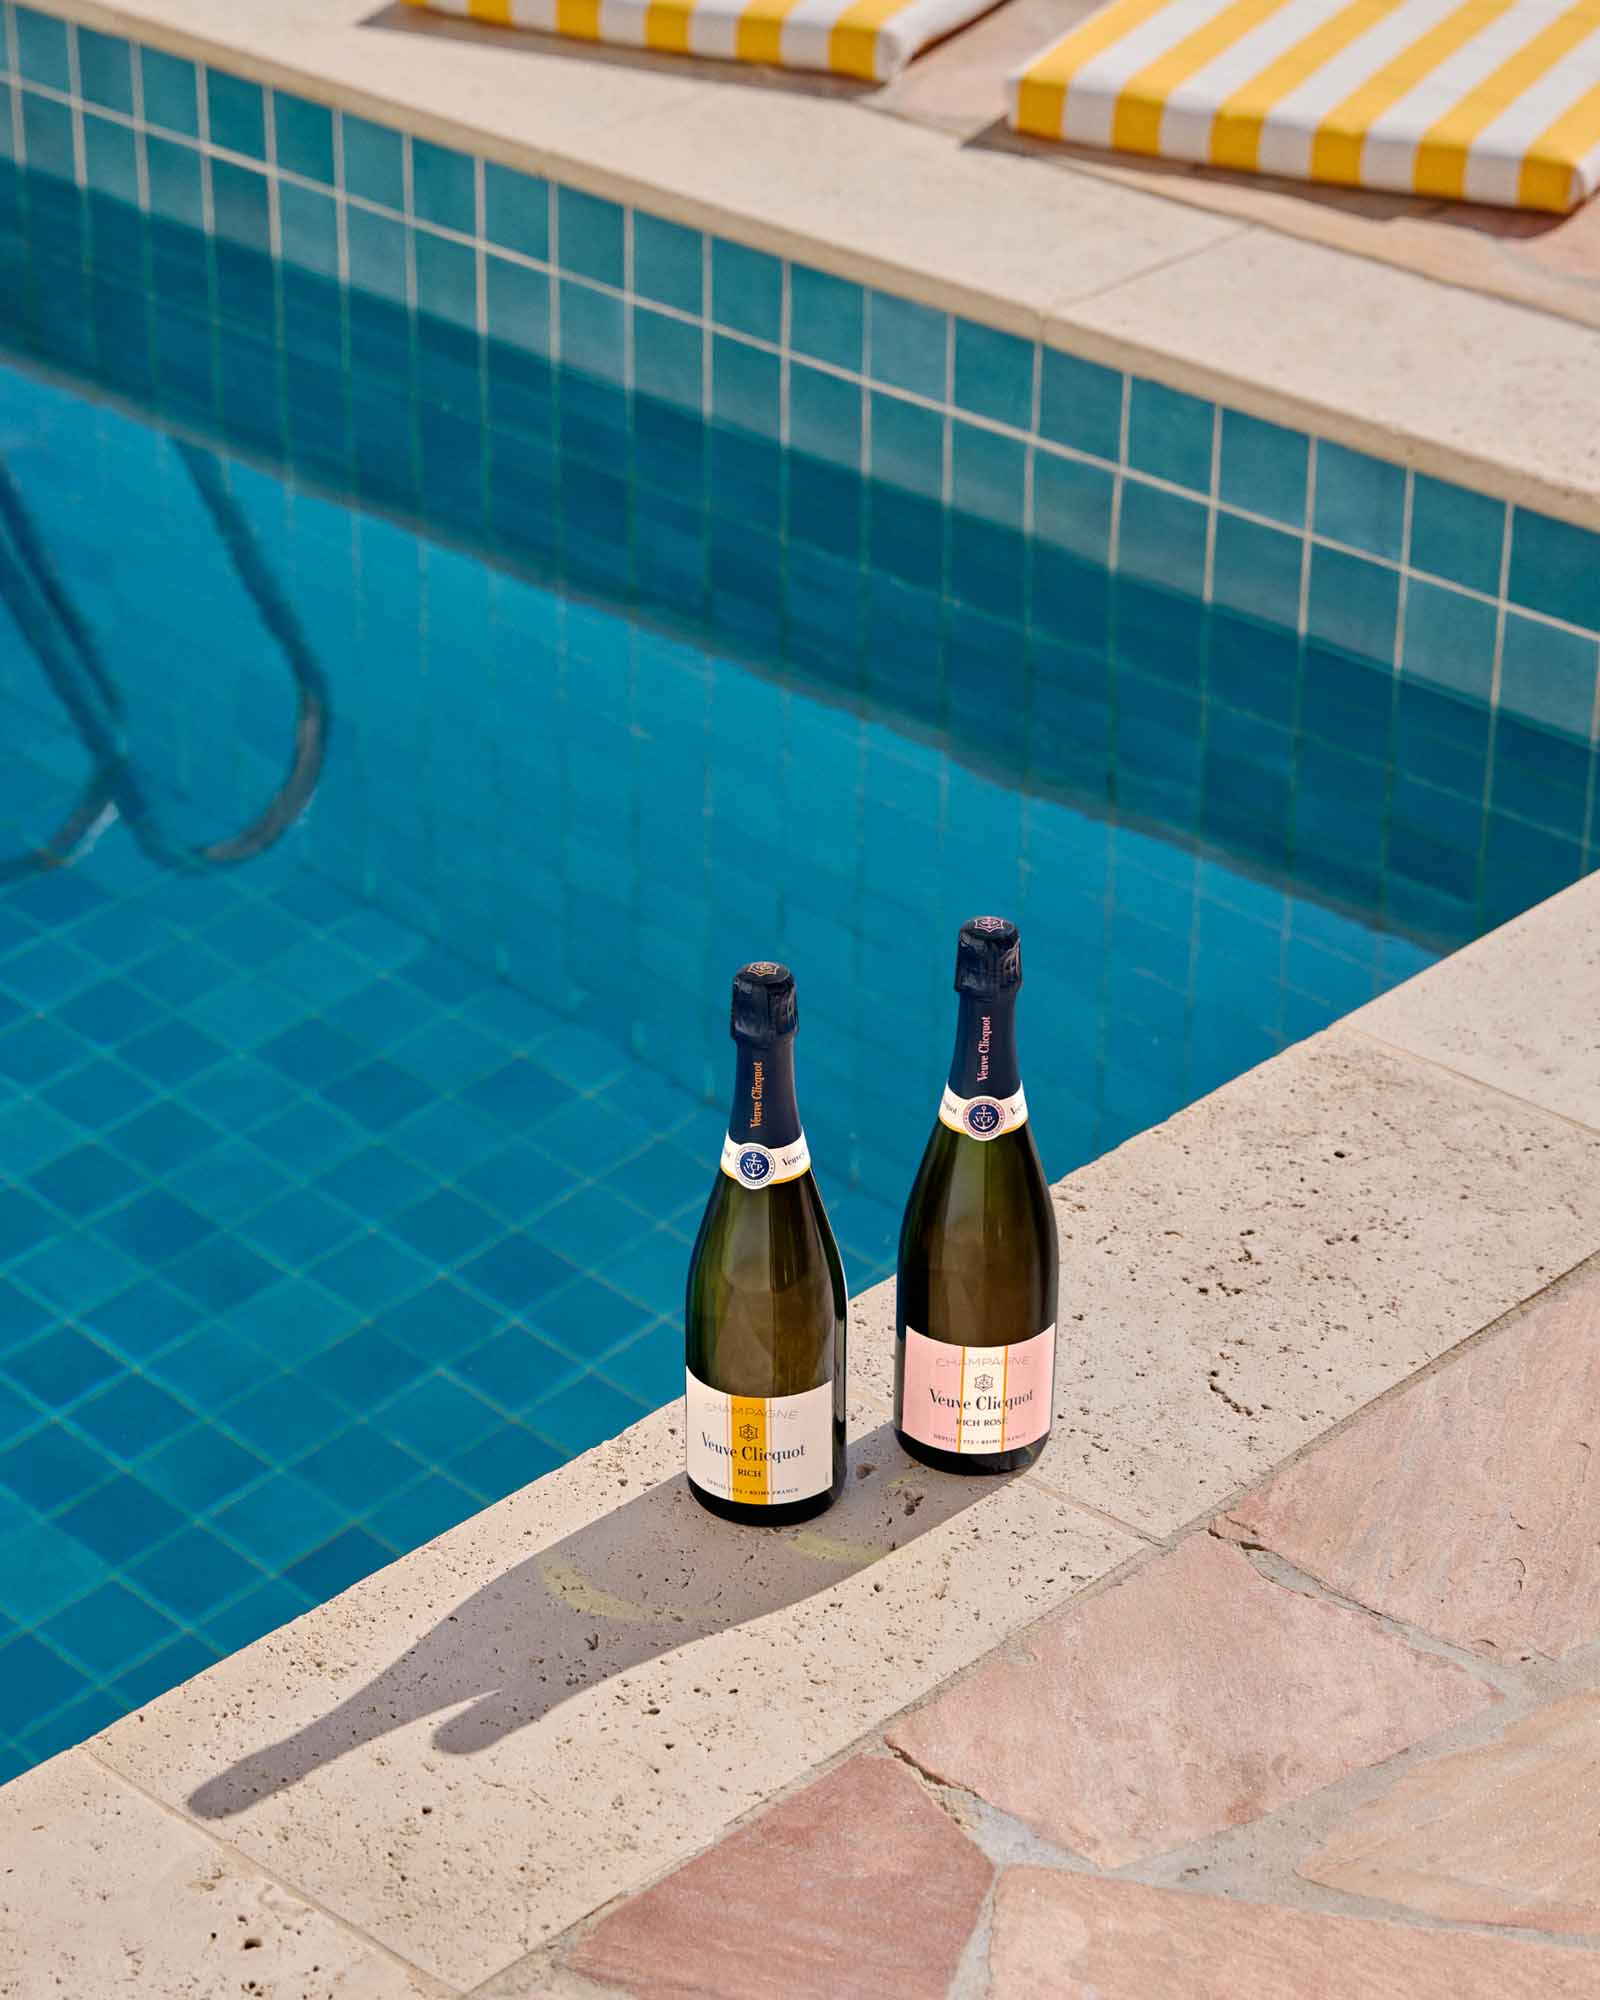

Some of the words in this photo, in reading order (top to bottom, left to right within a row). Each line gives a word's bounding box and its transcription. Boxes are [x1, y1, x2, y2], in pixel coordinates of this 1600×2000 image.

[977, 1015, 993, 1053] Clicquot
[751, 1061, 766, 1099] Clicquot
[976, 1055, 990, 1082] Veuve
[750, 1102, 763, 1128] Veuve
[745, 1161, 763, 1171] VCP
[704, 1402, 799, 1420] CHAMPAGNE
[929, 1388, 971, 1409] Veuve
[976, 1389, 1034, 1411] Clicquot
[956, 1418, 980, 1427] RICH
[702, 1431, 738, 1458] Veuve
[742, 1444, 806, 1463] Clicquot
[737, 1468, 762, 1478] RICH
